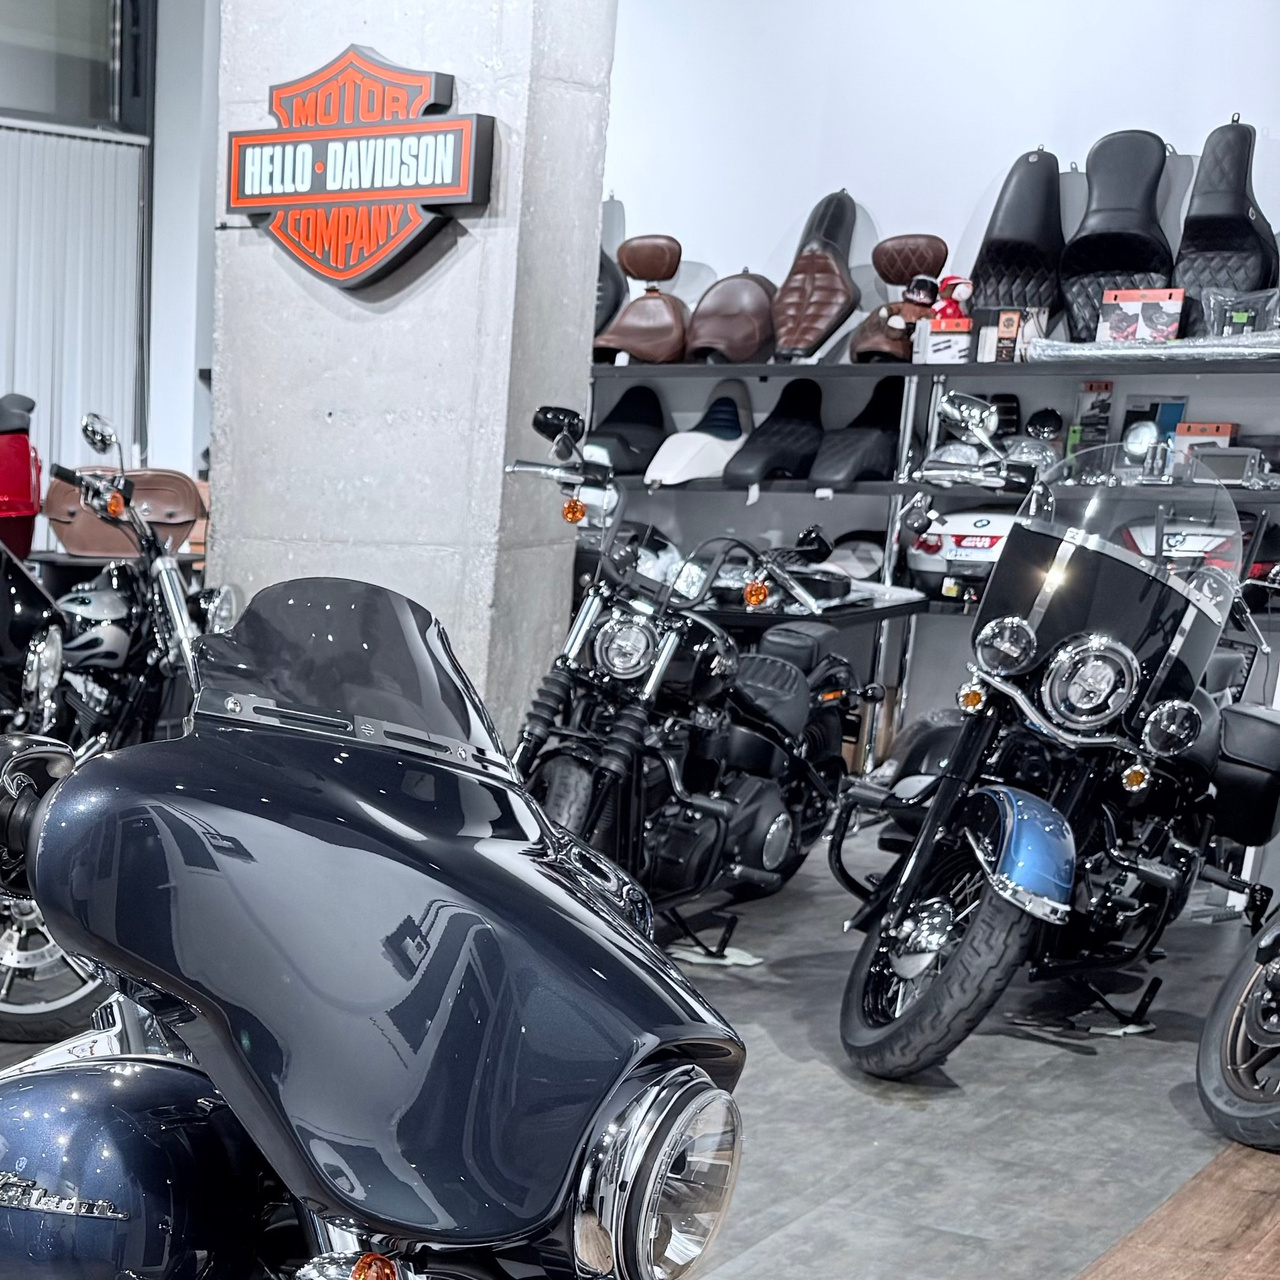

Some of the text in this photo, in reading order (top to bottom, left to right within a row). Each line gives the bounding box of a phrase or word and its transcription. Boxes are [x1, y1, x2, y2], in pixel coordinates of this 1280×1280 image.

[292, 67, 409, 128] MOTOR
[244, 134, 455, 195] HELLO DAVIDSON
[287, 203, 405, 269] COMPANY
